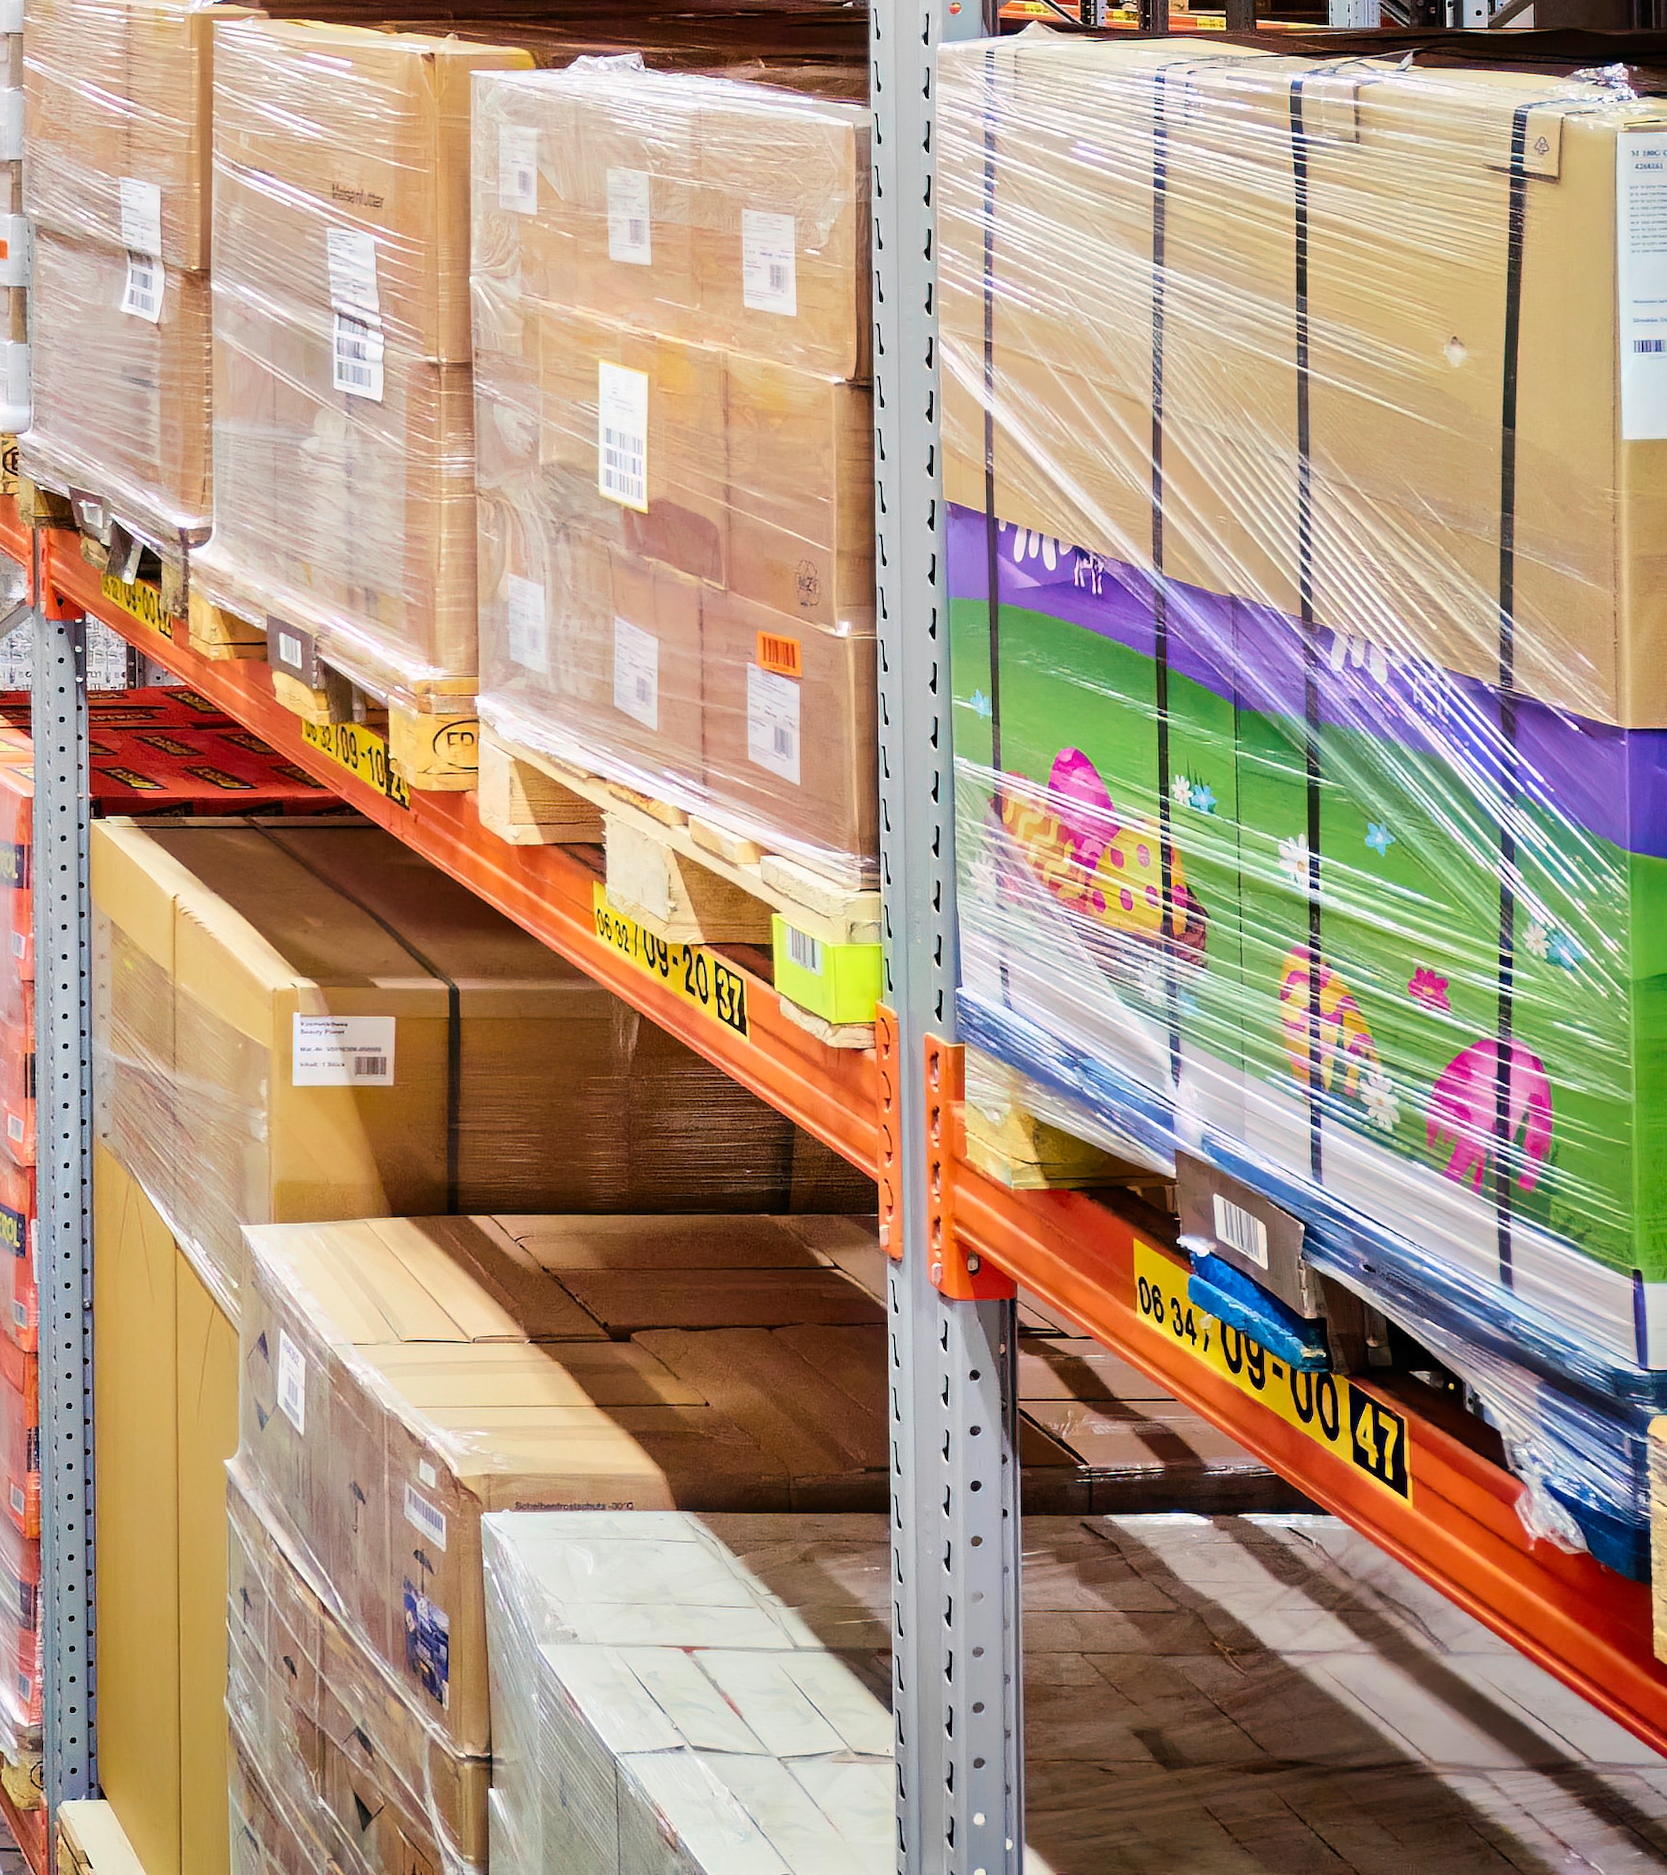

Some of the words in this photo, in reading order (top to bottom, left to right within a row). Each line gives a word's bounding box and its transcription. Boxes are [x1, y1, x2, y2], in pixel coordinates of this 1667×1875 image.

[596, 906, 611, 939] 06
[616, 919, 631, 952] 32
[716, 963, 747, 1031] 37
[1137, 1276, 1165, 1324] 06
[1170, 1297, 1196, 1346] 34
[1352, 1395, 1402, 1487] 47
